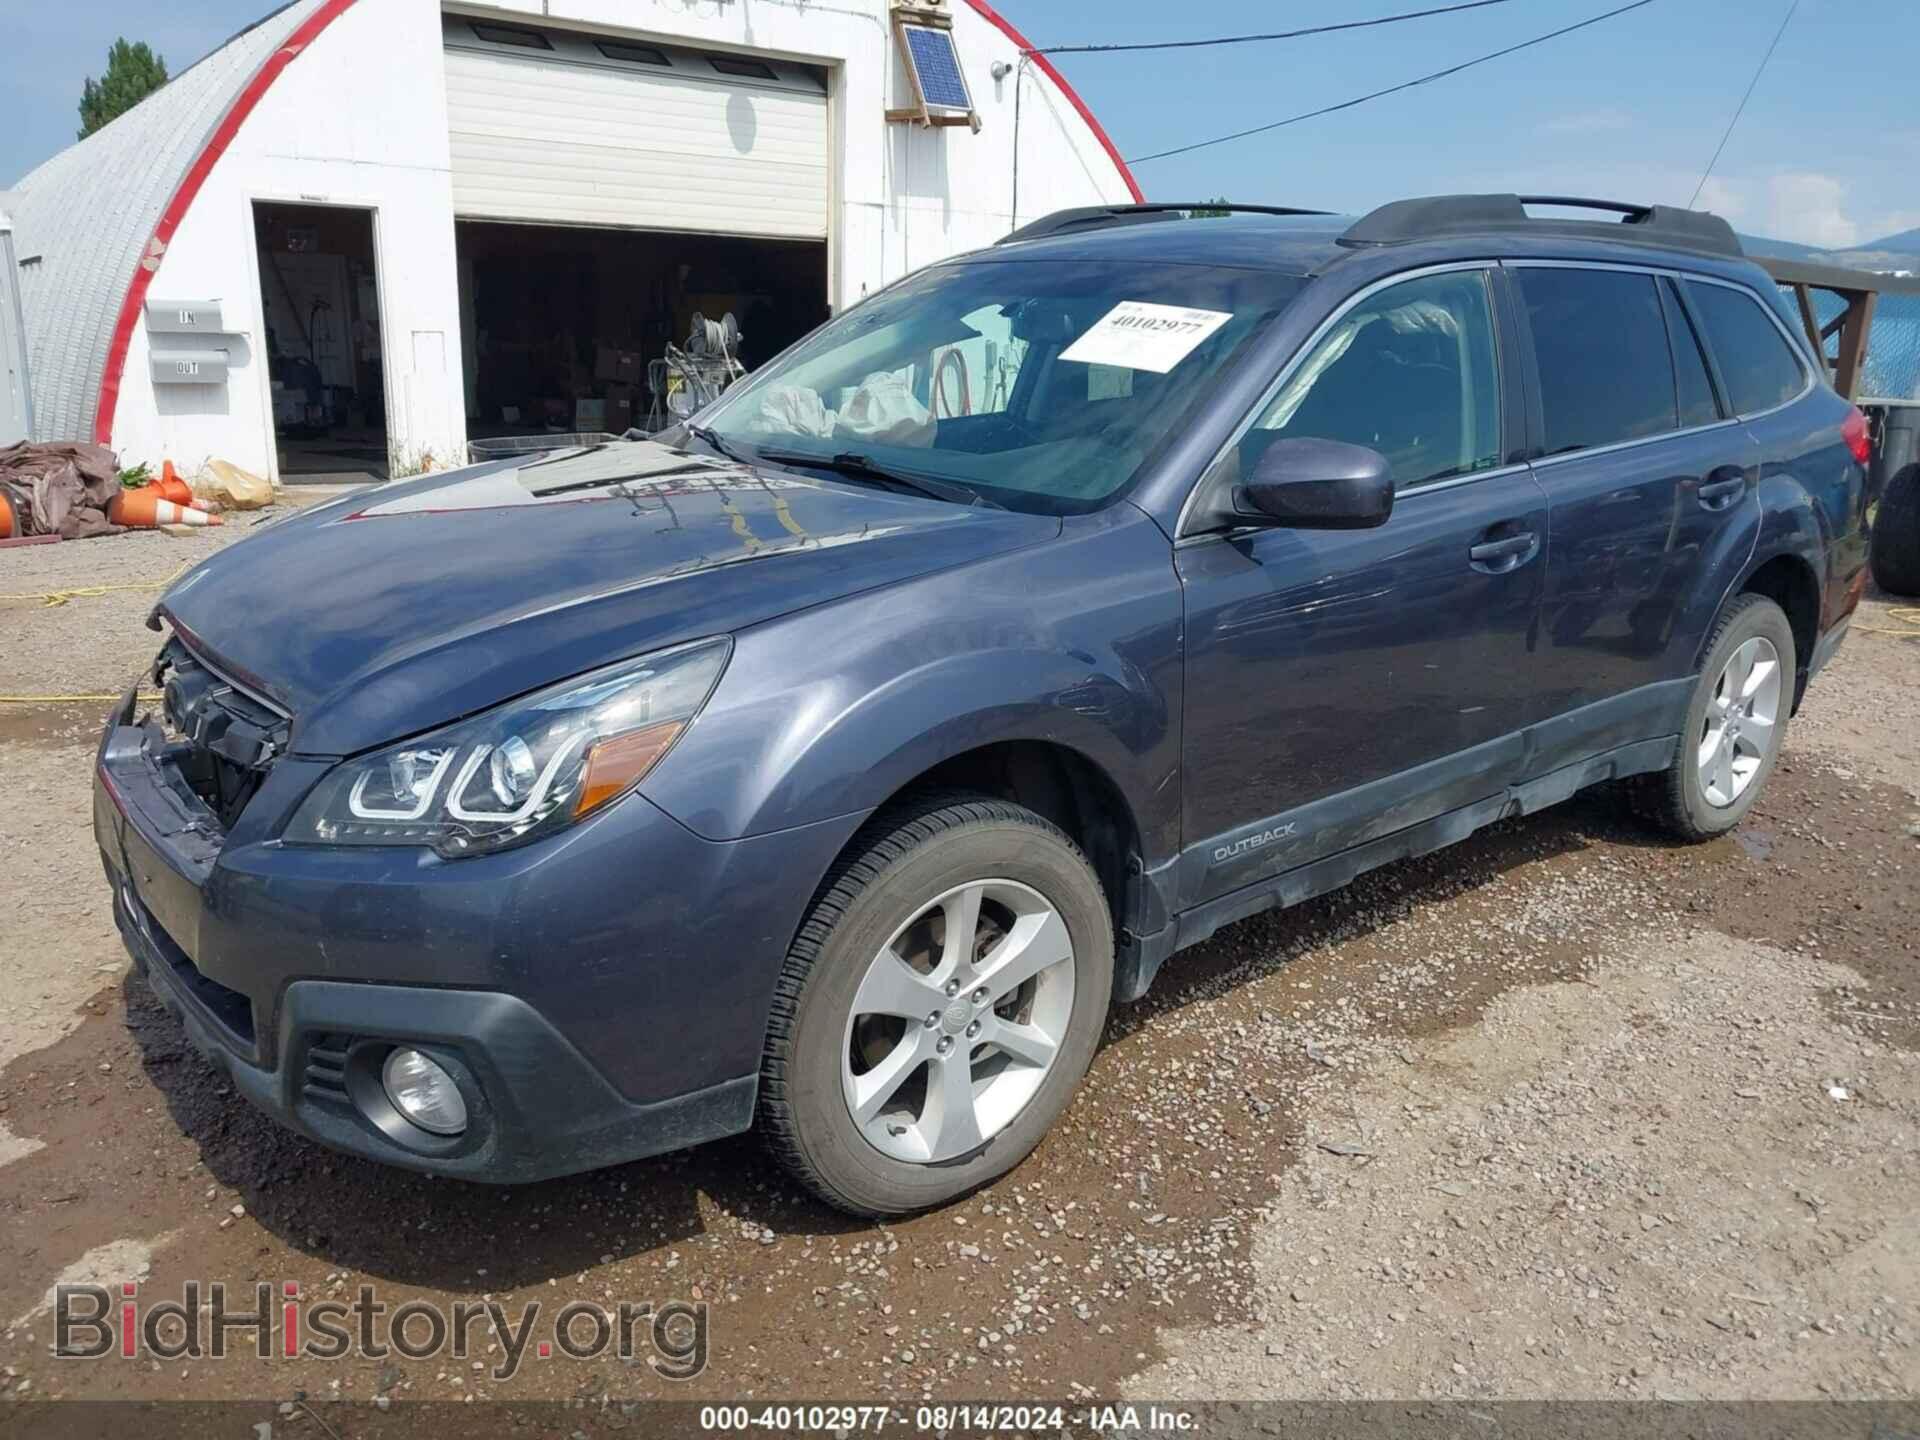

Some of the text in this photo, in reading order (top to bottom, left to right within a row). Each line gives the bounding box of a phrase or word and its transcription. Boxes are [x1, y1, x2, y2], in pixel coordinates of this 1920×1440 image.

[180, 311, 195, 324] IN
[1111, 314, 1203, 334] 40102977
[176, 361, 199, 374] OUT
[1214, 822, 1297, 861] OUTBACK
